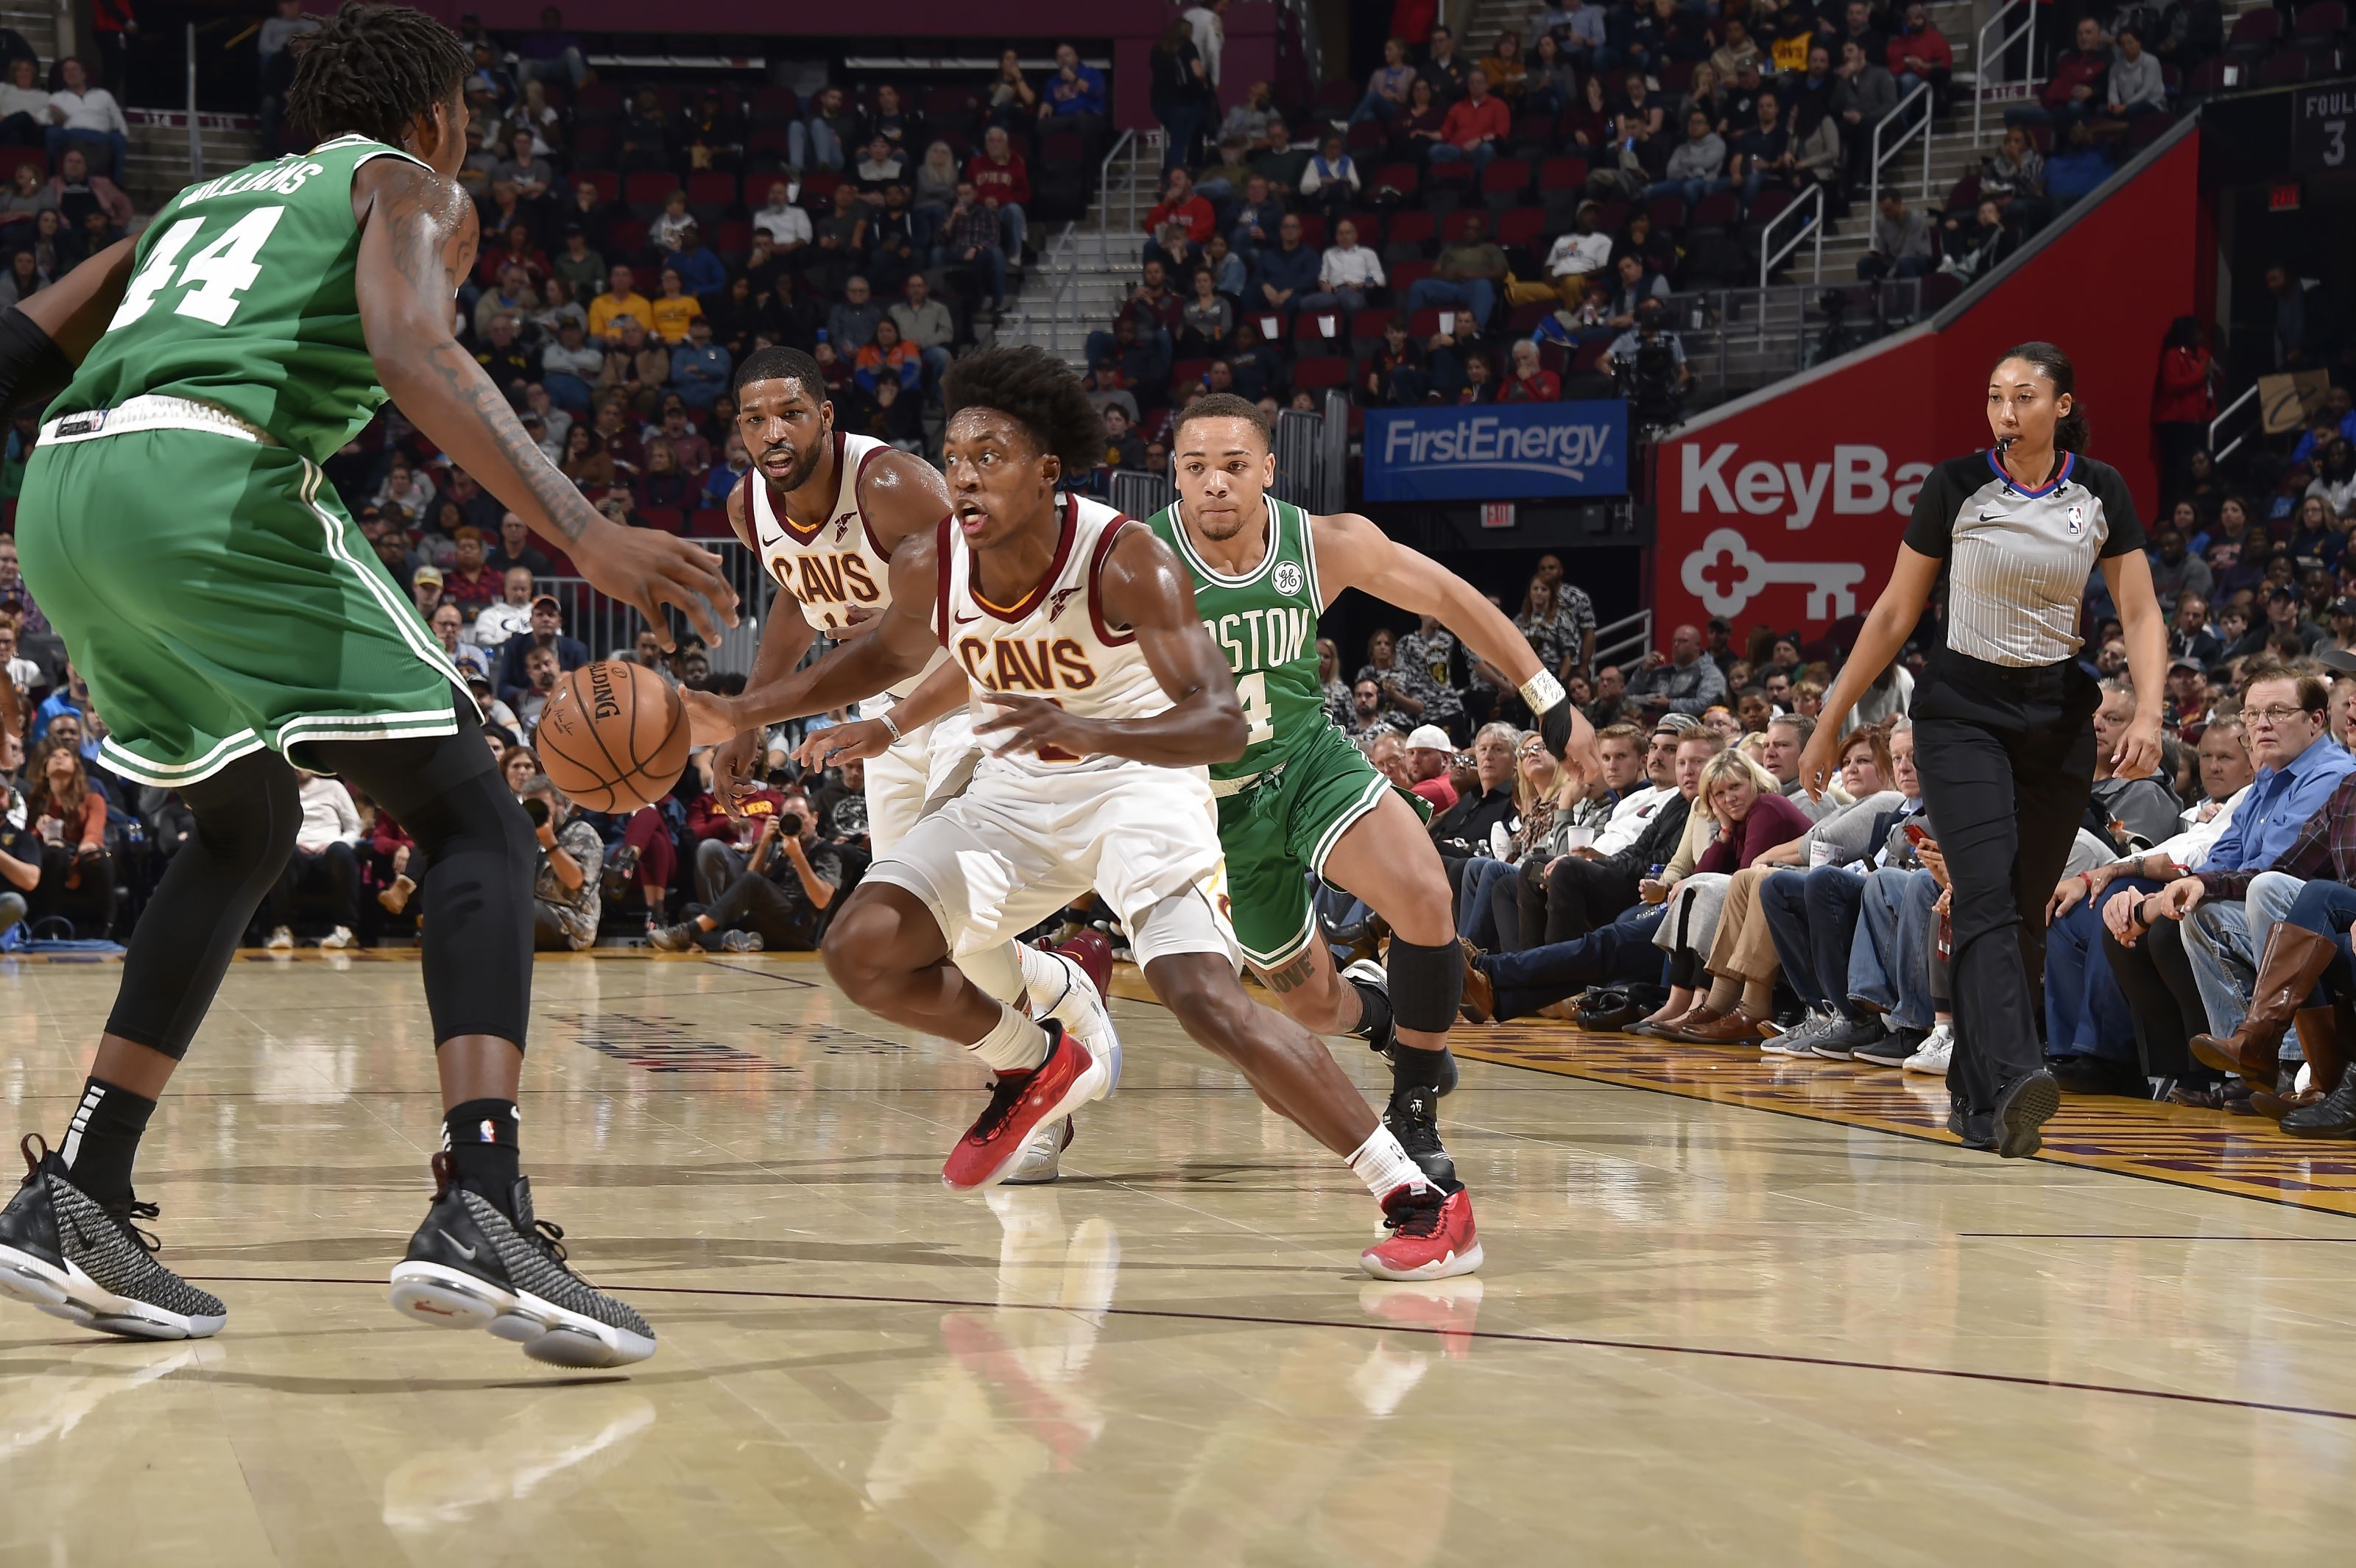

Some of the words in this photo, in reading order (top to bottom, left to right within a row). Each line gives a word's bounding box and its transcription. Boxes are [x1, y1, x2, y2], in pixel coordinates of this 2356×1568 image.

[2306, 91, 2356, 119] FOUL
[2323, 120, 2346, 166] 3
[178, 161, 324, 209] WILLIAMS
[106, 205, 286, 332] 44
[1384, 417, 1610, 467] FirstEnergy
[1681, 443, 1938, 530] KeyBa
[772, 551, 882, 607] CAVS
[959, 636, 1098, 693] CAVS
[1203, 607, 1311, 673] STON
[1235, 671, 1274, 746] 4
